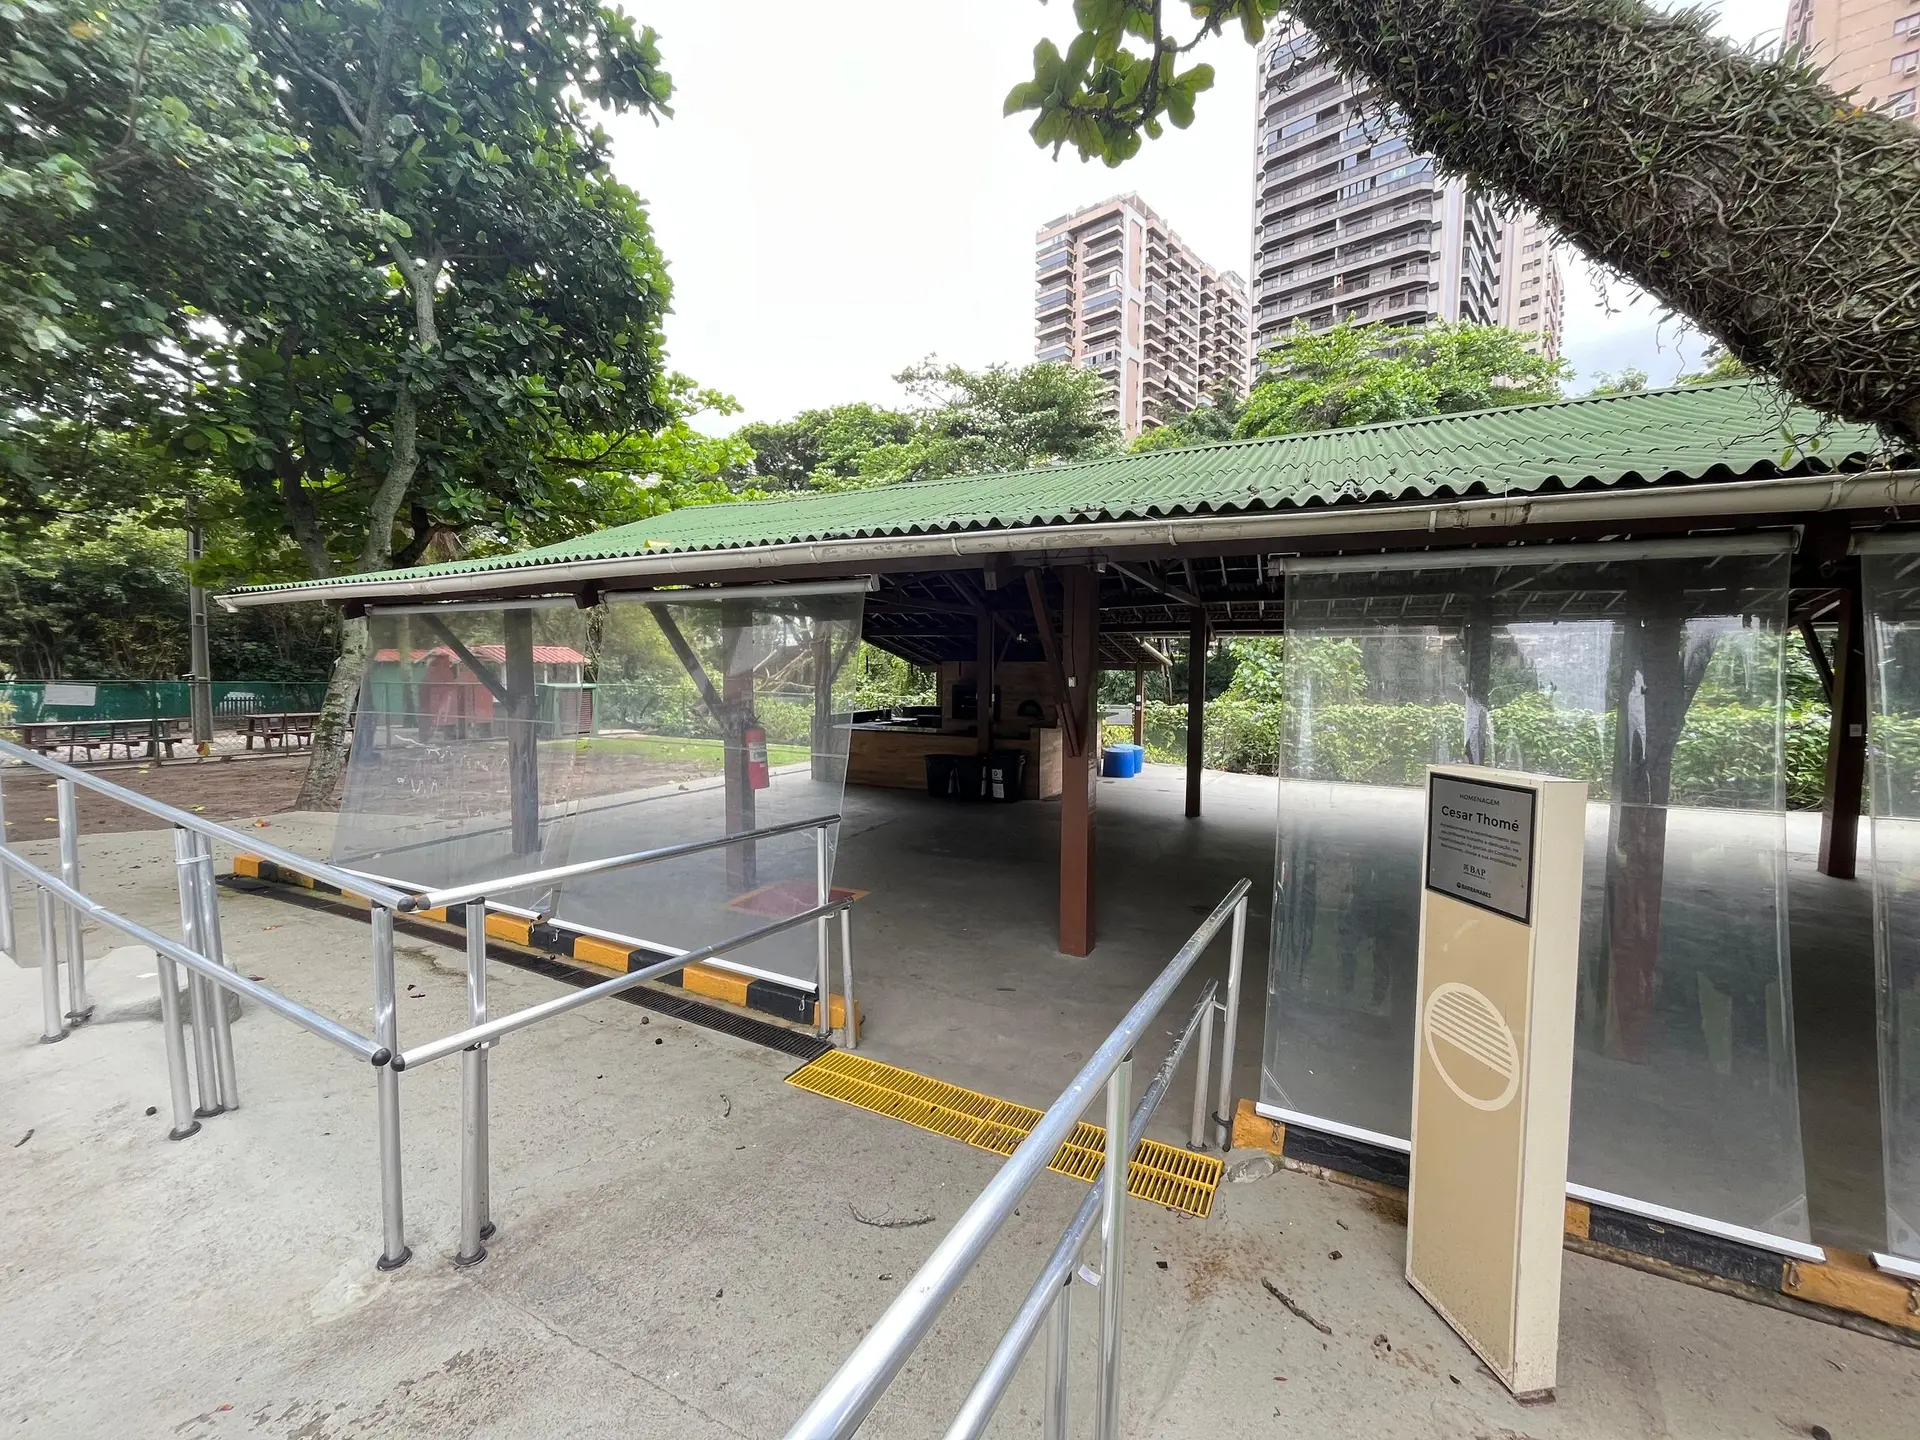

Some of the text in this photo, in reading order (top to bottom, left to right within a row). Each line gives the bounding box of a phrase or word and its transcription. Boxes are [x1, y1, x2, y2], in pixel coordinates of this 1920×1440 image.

[1460, 794, 1500, 806] HOMENAGEM
[1441, 805, 1520, 832] Cesar Thomé
[1470, 865, 1486, 876] BAP
[1461, 884, 1492, 898] BARRAMARES
